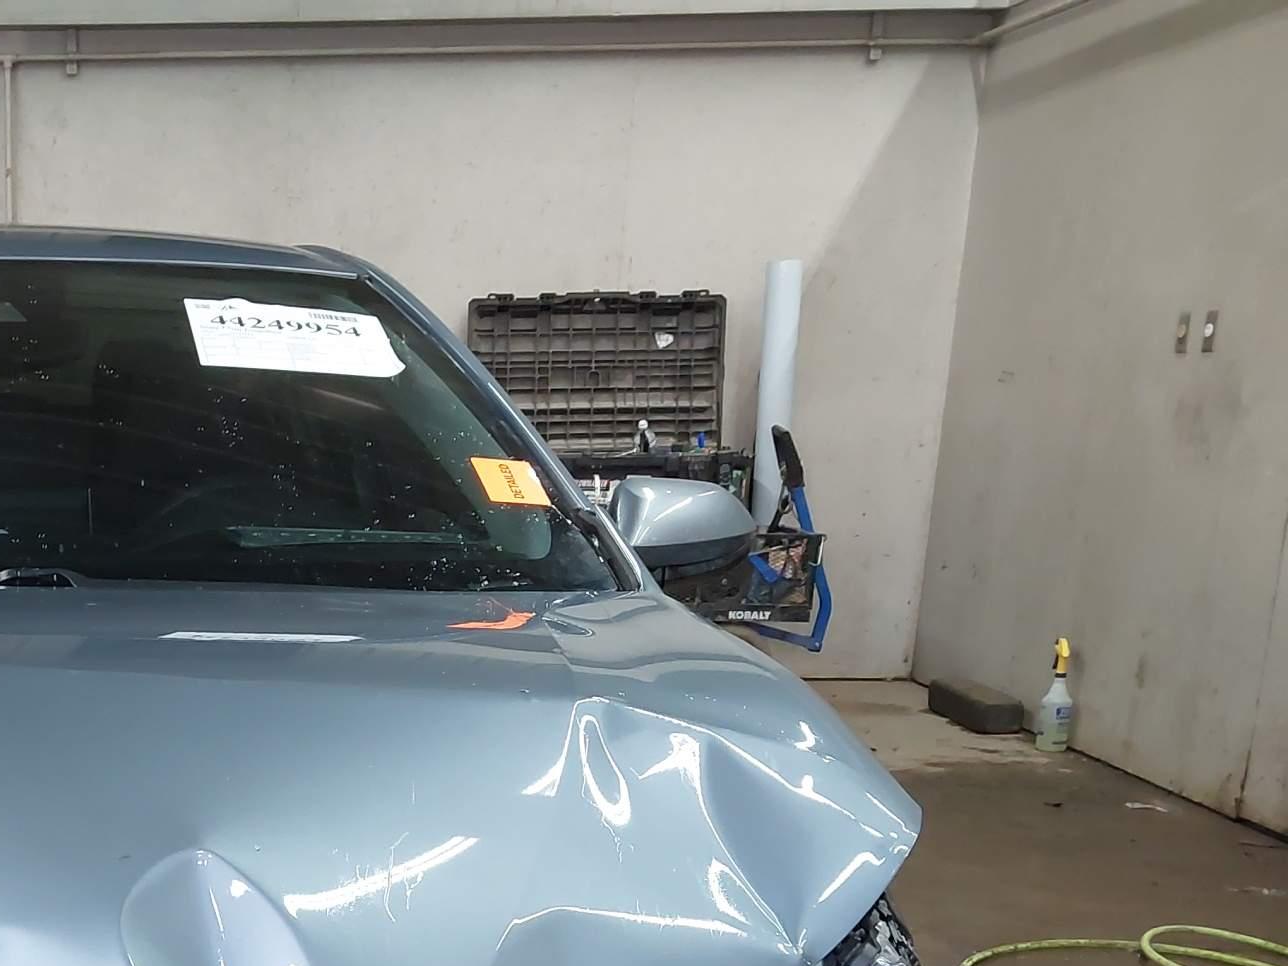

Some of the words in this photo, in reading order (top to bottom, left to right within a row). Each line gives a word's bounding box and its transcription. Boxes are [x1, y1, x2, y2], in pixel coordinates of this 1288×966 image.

[210, 314, 361, 337] 44249954
[498, 463, 525, 499] DETAILED
[728, 610, 771, 620] KOBALT
